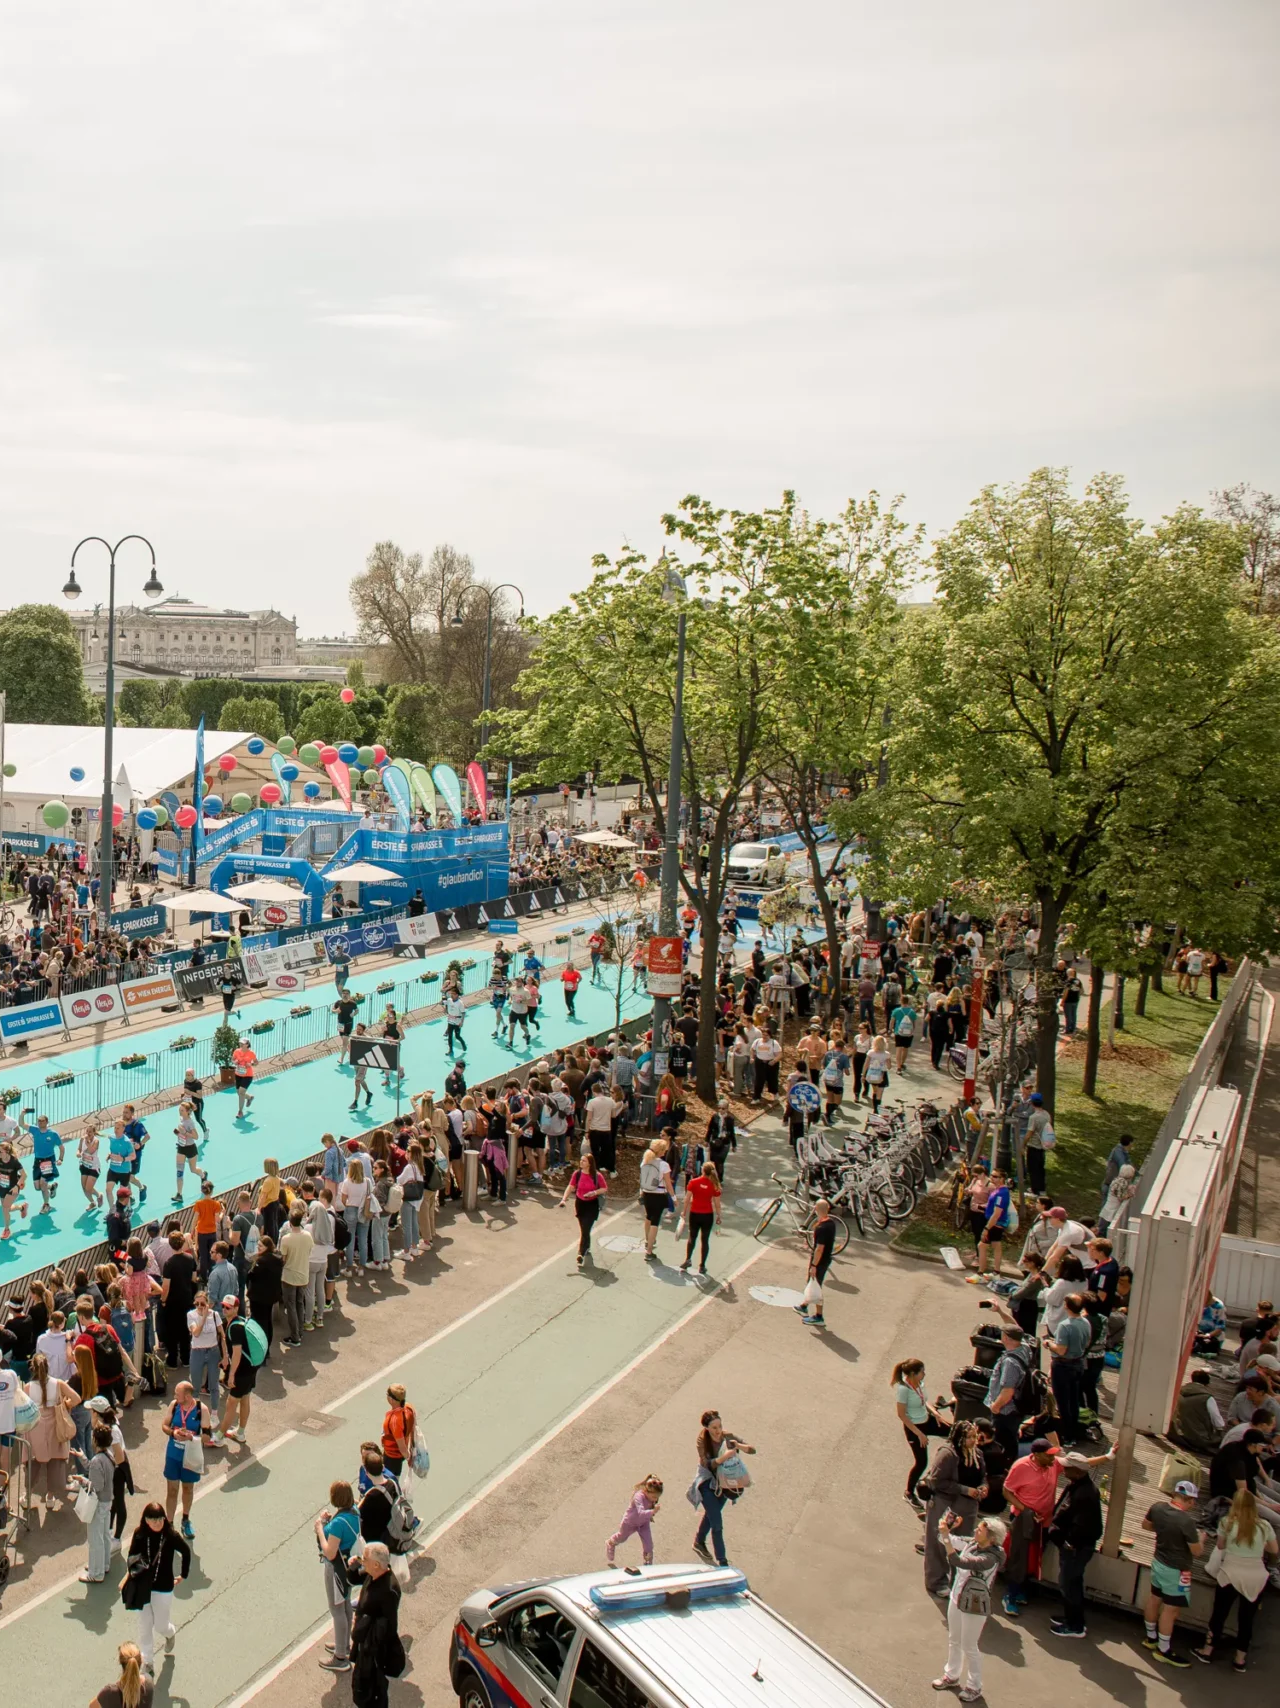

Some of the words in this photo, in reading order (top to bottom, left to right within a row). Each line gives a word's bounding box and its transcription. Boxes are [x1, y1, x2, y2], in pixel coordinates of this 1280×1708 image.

[214, 823, 251, 848] SPARKASSE
[372, 840, 398, 850] ERSTE
[438, 870, 483, 888] #glaubandich
[122, 916, 154, 932] SPARKASSE
[26, 1014, 51, 1025] SPARKASSE
